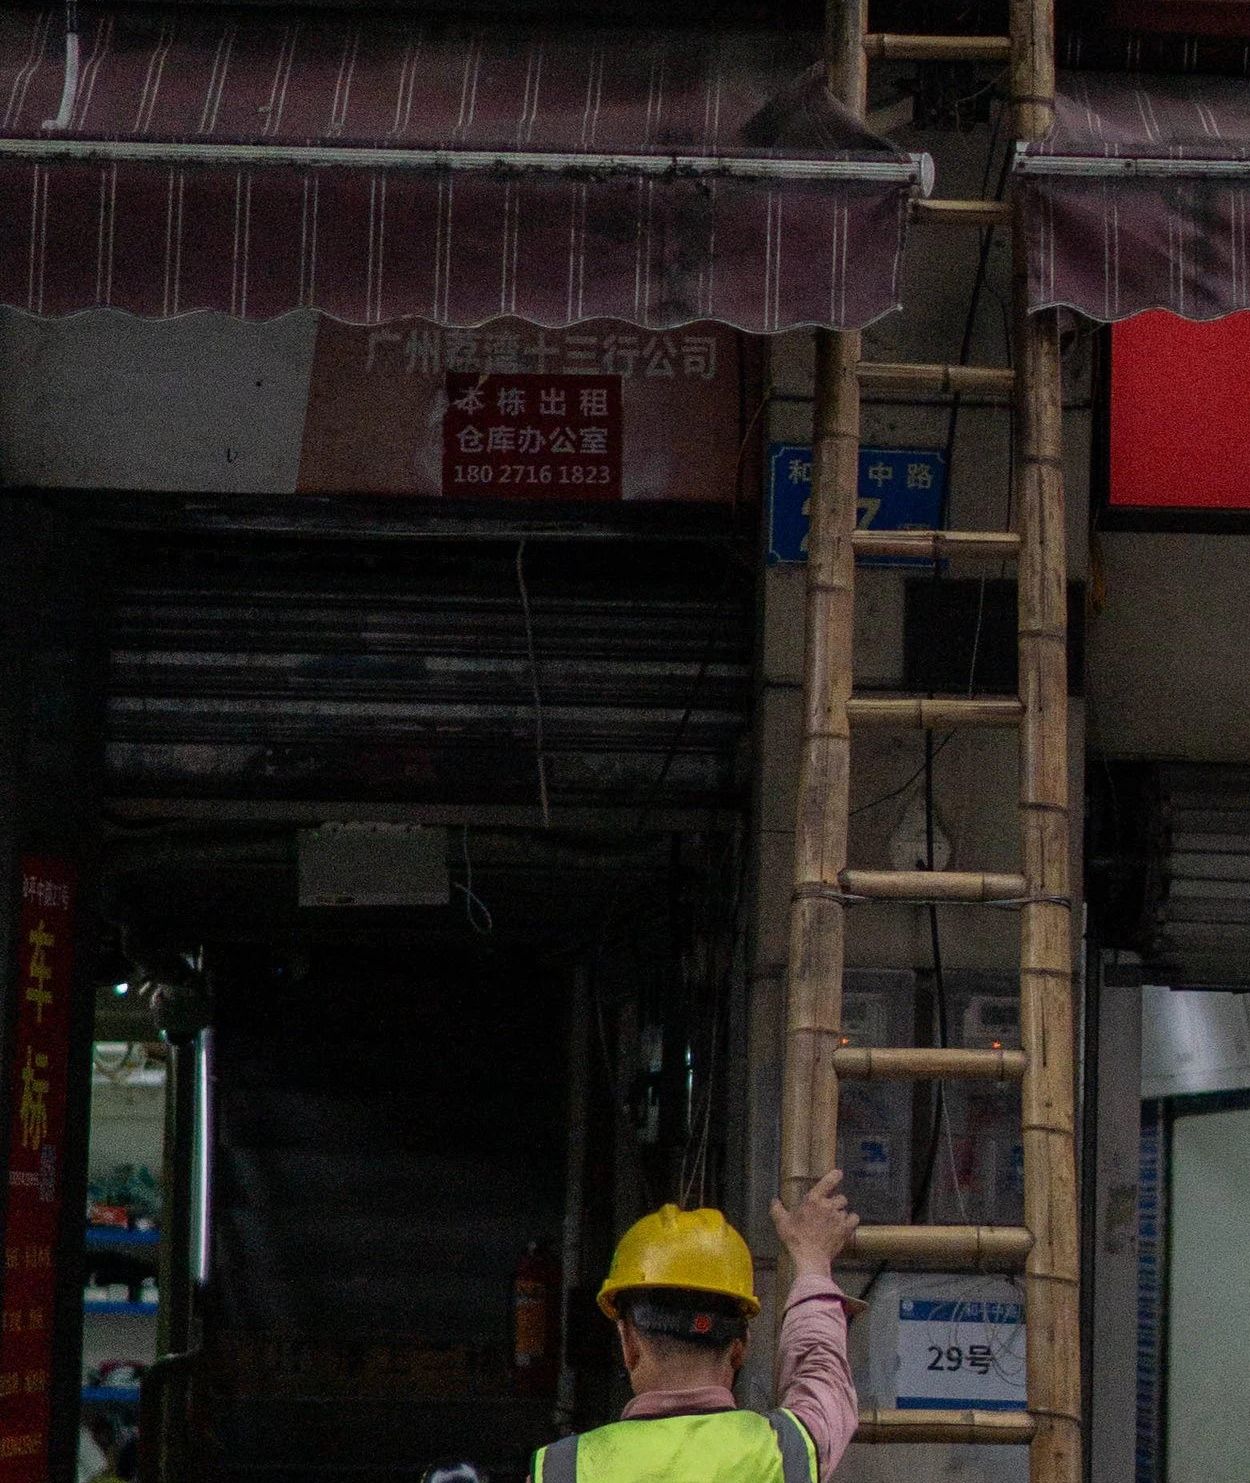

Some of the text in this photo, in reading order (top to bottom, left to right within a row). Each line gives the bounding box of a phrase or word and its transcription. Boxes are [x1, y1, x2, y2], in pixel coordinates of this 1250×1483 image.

[451, 385, 610, 417] 本栋出租
[455, 425, 609, 455] 仓库办公室
[452, 464, 613, 486] 180 2716 1823
[787, 459, 934, 490] 和中路
[927, 1344, 991, 1376] 29号
